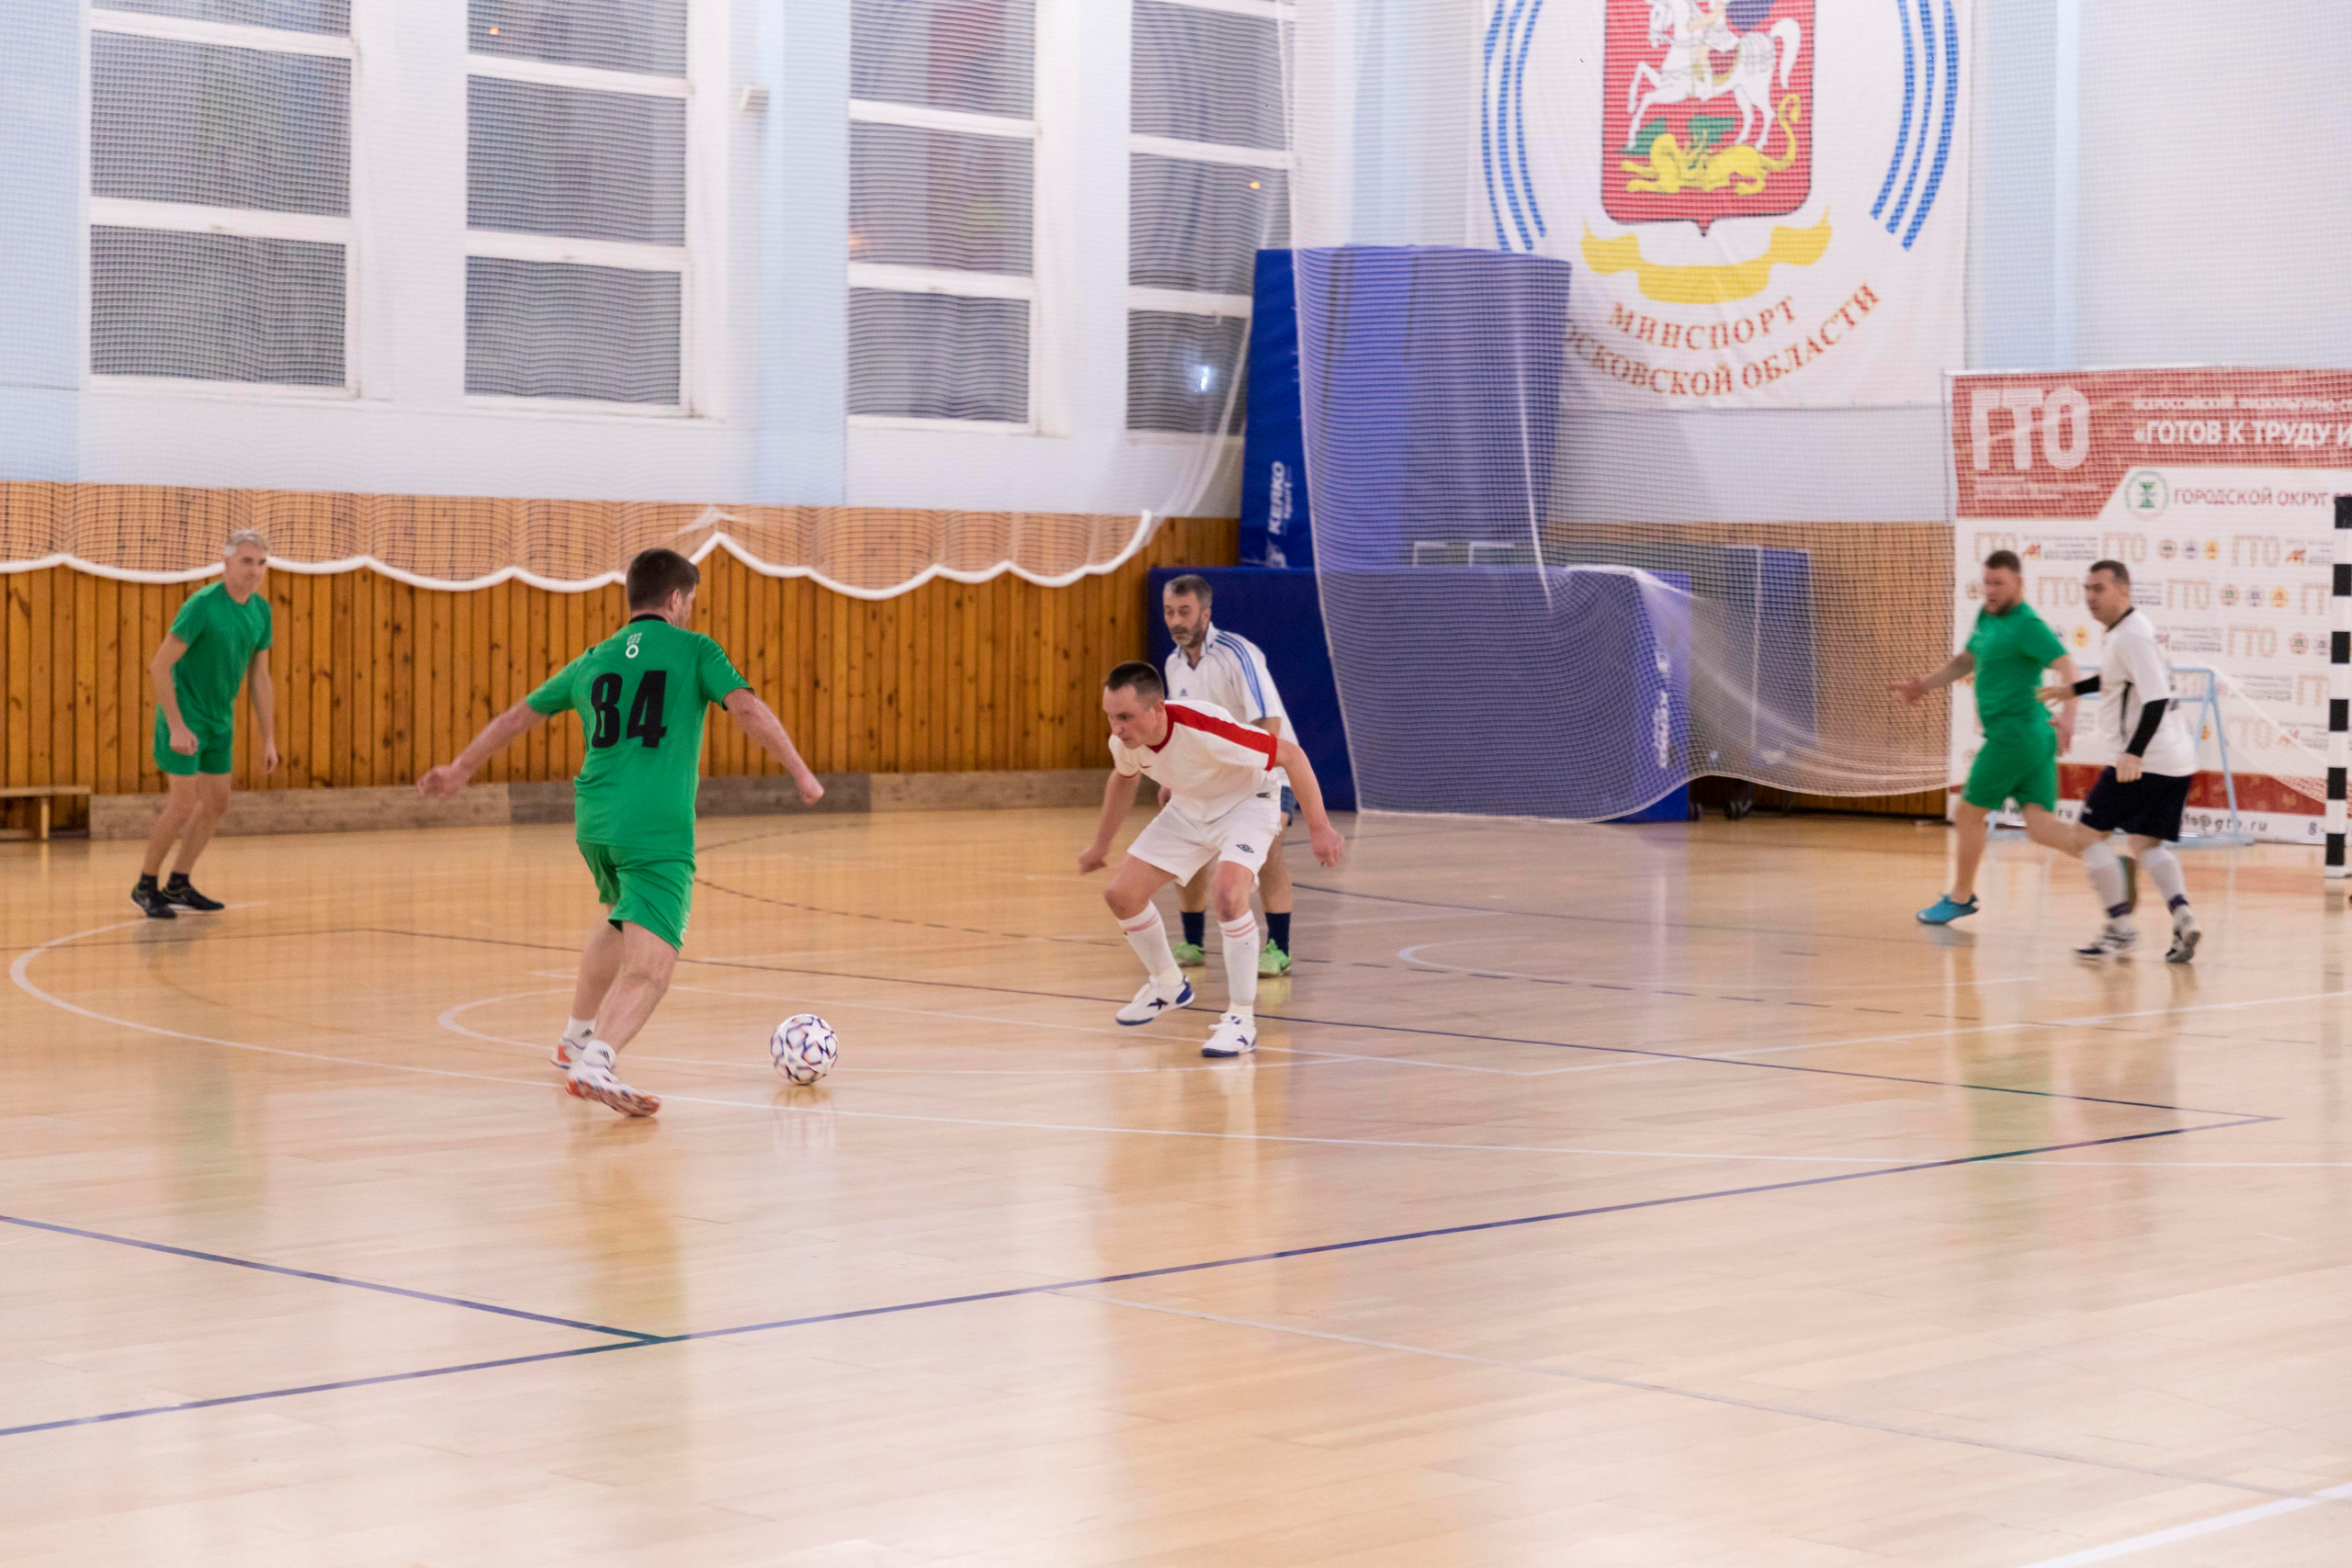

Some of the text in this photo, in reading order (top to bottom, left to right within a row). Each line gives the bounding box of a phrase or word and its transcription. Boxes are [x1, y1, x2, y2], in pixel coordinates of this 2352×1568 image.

[1566, 281, 1881, 398] СКОВСКОЙ ОБЛАСТИ
[1608, 295, 1799, 351] МИНСПОРТ
[1971, 388, 2090, 470] ГТО
[2133, 420, 2222, 445] «ГОТОВ
[2229, 420, 2245, 445] К
[2253, 422, 2331, 450] ТРУДУ
[2174, 486, 2329, 506] ГОРОДСКОЙ ОКРУГ
[2301, 582, 2334, 616] ГТ
[591, 670, 668, 749] 84
[2298, 674, 2331, 707] ГТ
